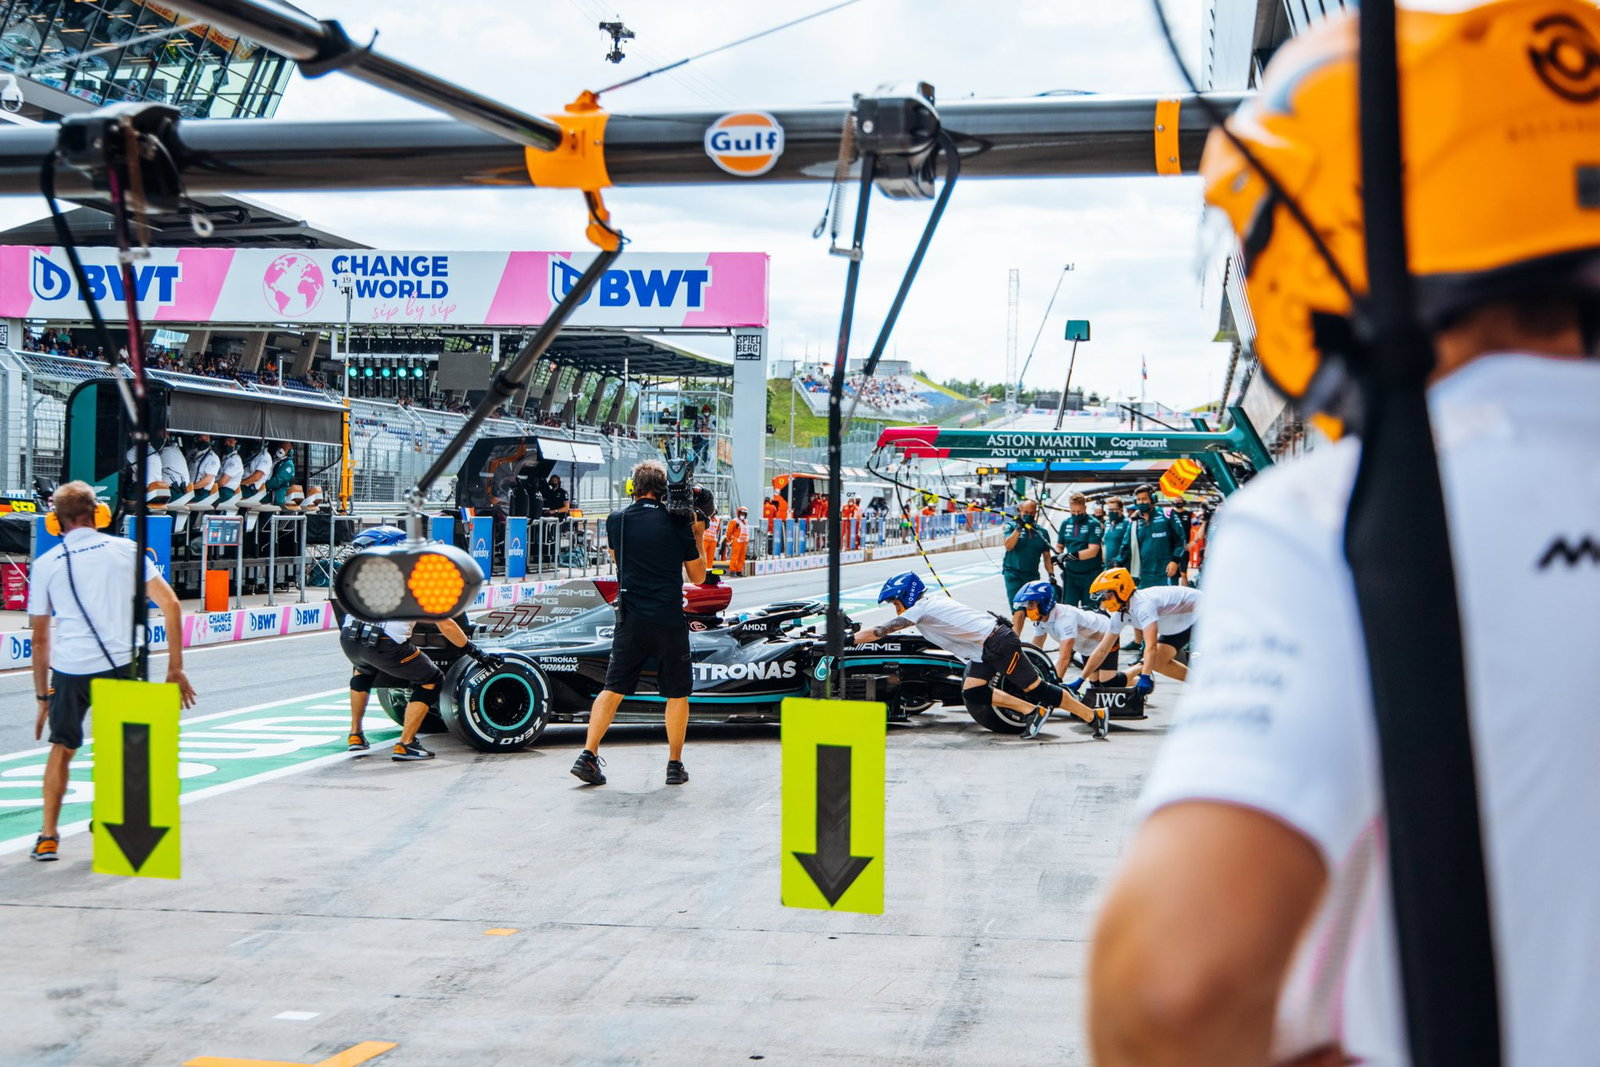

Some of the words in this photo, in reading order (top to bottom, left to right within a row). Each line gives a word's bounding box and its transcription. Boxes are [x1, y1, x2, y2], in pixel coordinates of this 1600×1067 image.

[710, 131, 777, 151] Gulf
[331, 255, 449, 277] CHANGE
[78, 264, 179, 302] BWT
[356, 280, 449, 298] WORLD
[600, 270, 708, 307] BWT
[372, 303, 399, 320] sip
[405, 291, 425, 321] by
[430, 301, 457, 321] sip
[986, 434, 1035, 447] ASTON
[1040, 435, 1096, 448] MARTIN
[1110, 437, 1168, 450] Cognizant
[990, 449, 1031, 457] ASTON
[557, 589, 596, 597] AMG
[208, 612, 232, 625] CHANGE
[257, 613, 277, 630] BWT
[302, 608, 320, 625] BWT
[488, 605, 542, 633] 77
[153, 625, 168, 643] BW
[213, 623, 232, 633] WORLD
[861, 643, 902, 651] AMG
[540, 663, 579, 672] PRIMAX
[691, 660, 797, 681] TRONAS
[1094, 692, 1126, 708] IWC
[500, 716, 543, 745] ZERO
